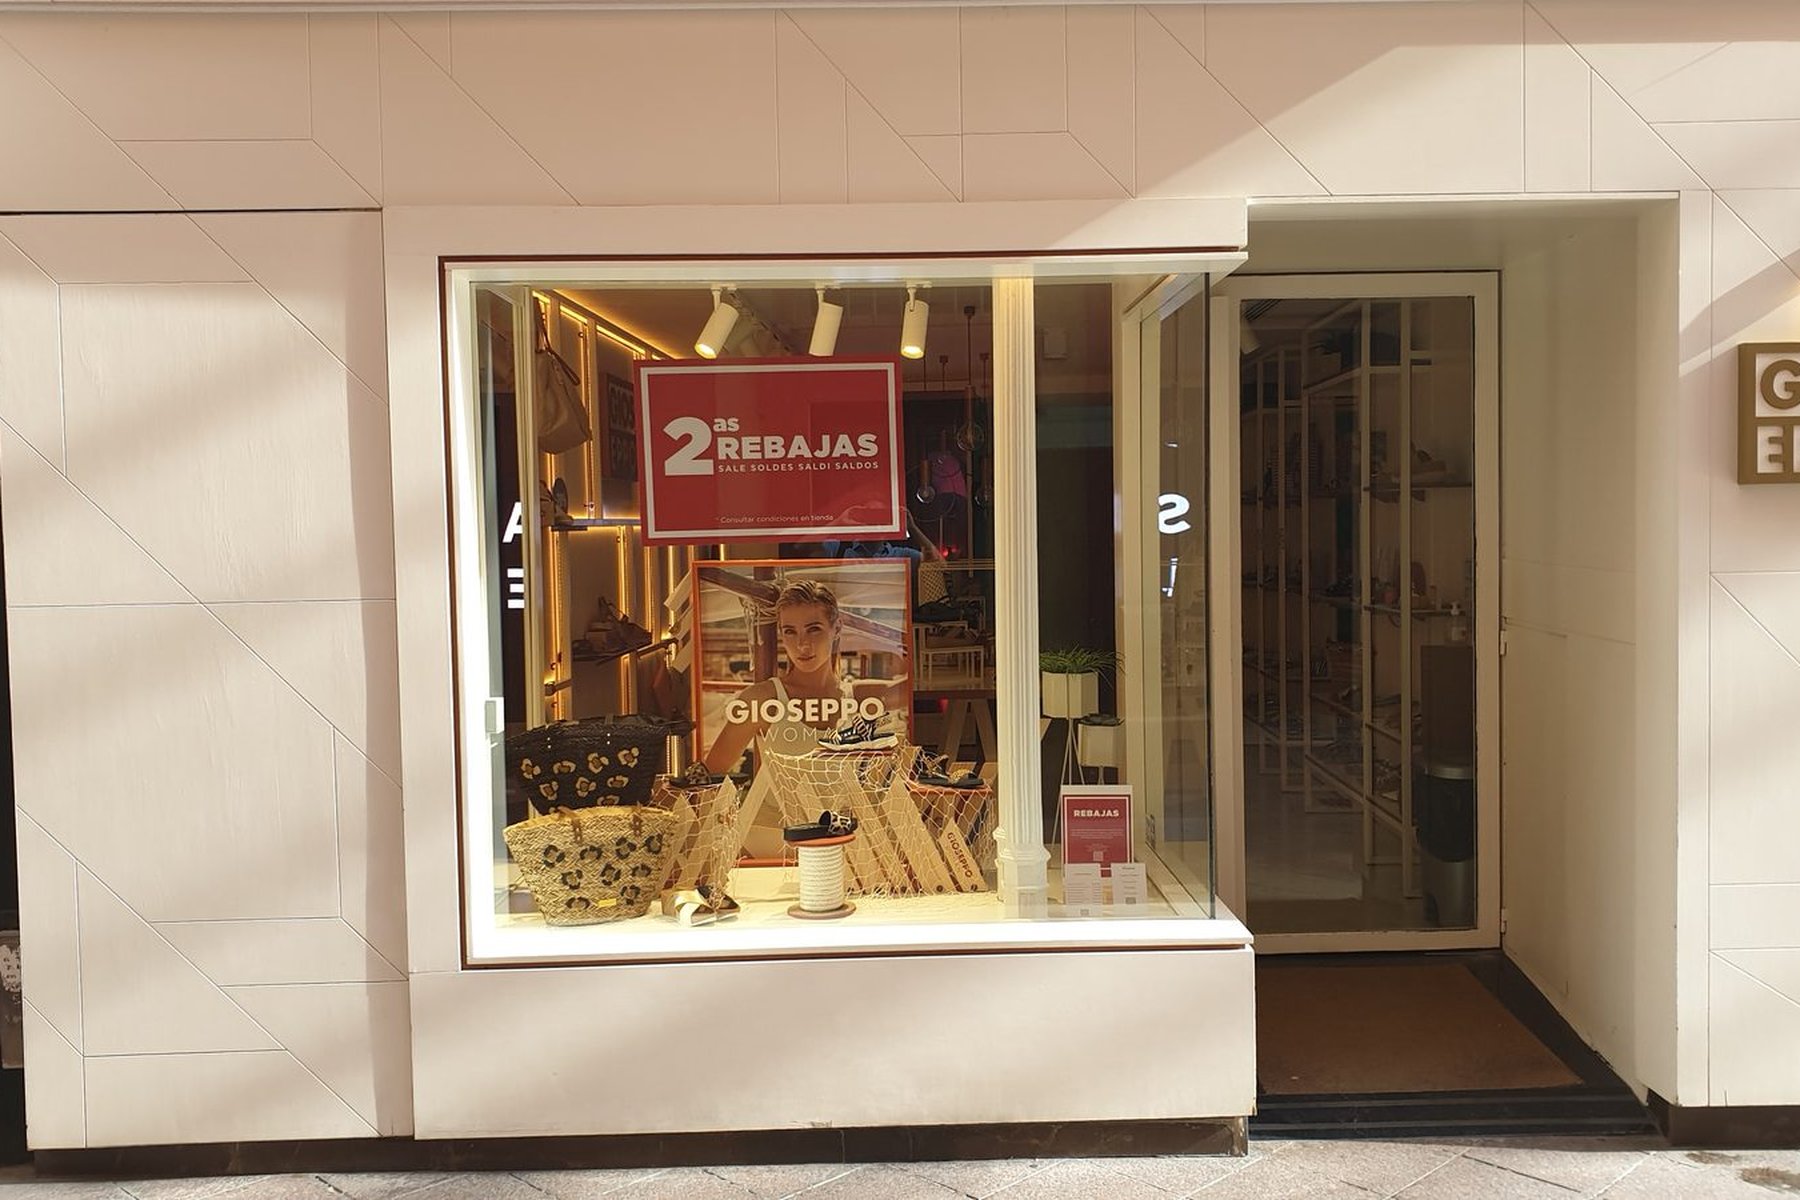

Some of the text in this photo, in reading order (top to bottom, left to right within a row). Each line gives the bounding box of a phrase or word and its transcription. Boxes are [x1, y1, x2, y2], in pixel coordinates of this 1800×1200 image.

[713, 418, 740, 432] as
[717, 433, 879, 460] REBAJAS
[718, 461, 879, 473] SALE SOLDES SALDI SALDOS
[756, 514, 799, 523] condiciones
[810, 513, 834, 521] tienda
[725, 696, 885, 724] GIOSEPPO
[1073, 809, 1120, 817] REBAJAS
[947, 832, 973, 878] GIOSEPPO
